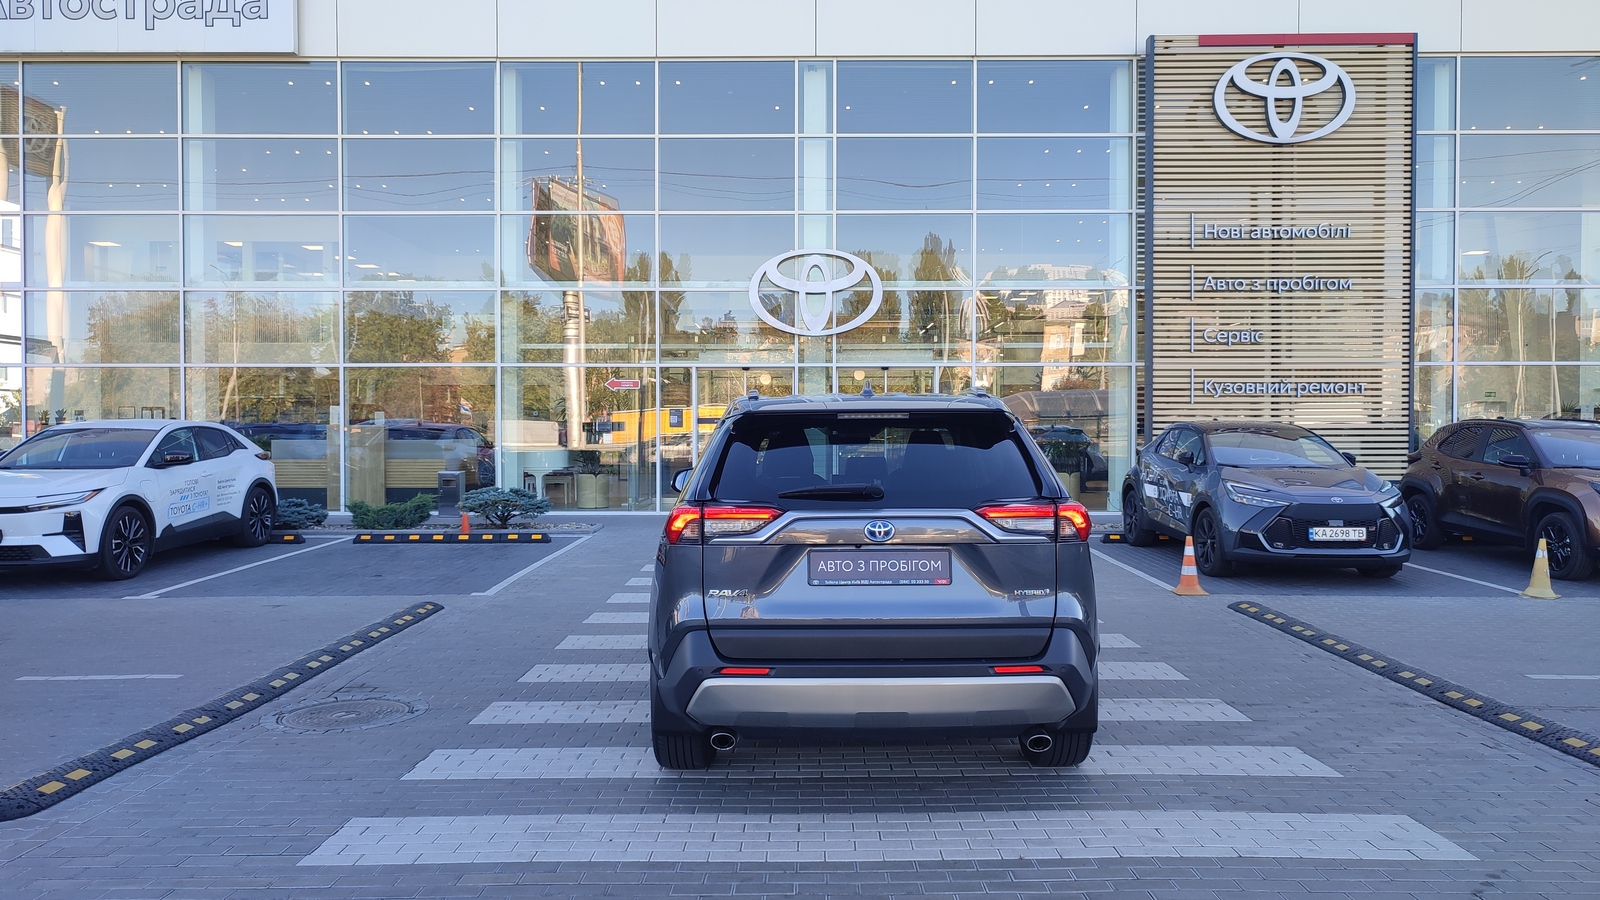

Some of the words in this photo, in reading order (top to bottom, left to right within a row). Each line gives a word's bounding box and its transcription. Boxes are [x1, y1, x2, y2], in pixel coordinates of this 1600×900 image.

[0, 0, 269, 30] втострада
[1203, 223, 1245, 239] Нові
[1250, 222, 1351, 239] автомобілі
[1203, 276, 1246, 291] Авто
[1251, 280, 1260, 291] з
[1266, 275, 1353, 294] пробігом
[1203, 327, 1265, 346] Сервіс
[1203, 379, 1292, 397] Кузовний
[1297, 381, 1367, 397] ремонт
[170, 504, 191, 516] TOYOTA
[1314, 529, 1328, 538] KA
[1329, 529, 1350, 538] 2698
[1352, 529, 1365, 538] TB
[817, 560, 853, 572] АВТО
[869, 560, 942, 572] ПРОБІГОМ
[708, 589, 748, 598] RAV4
